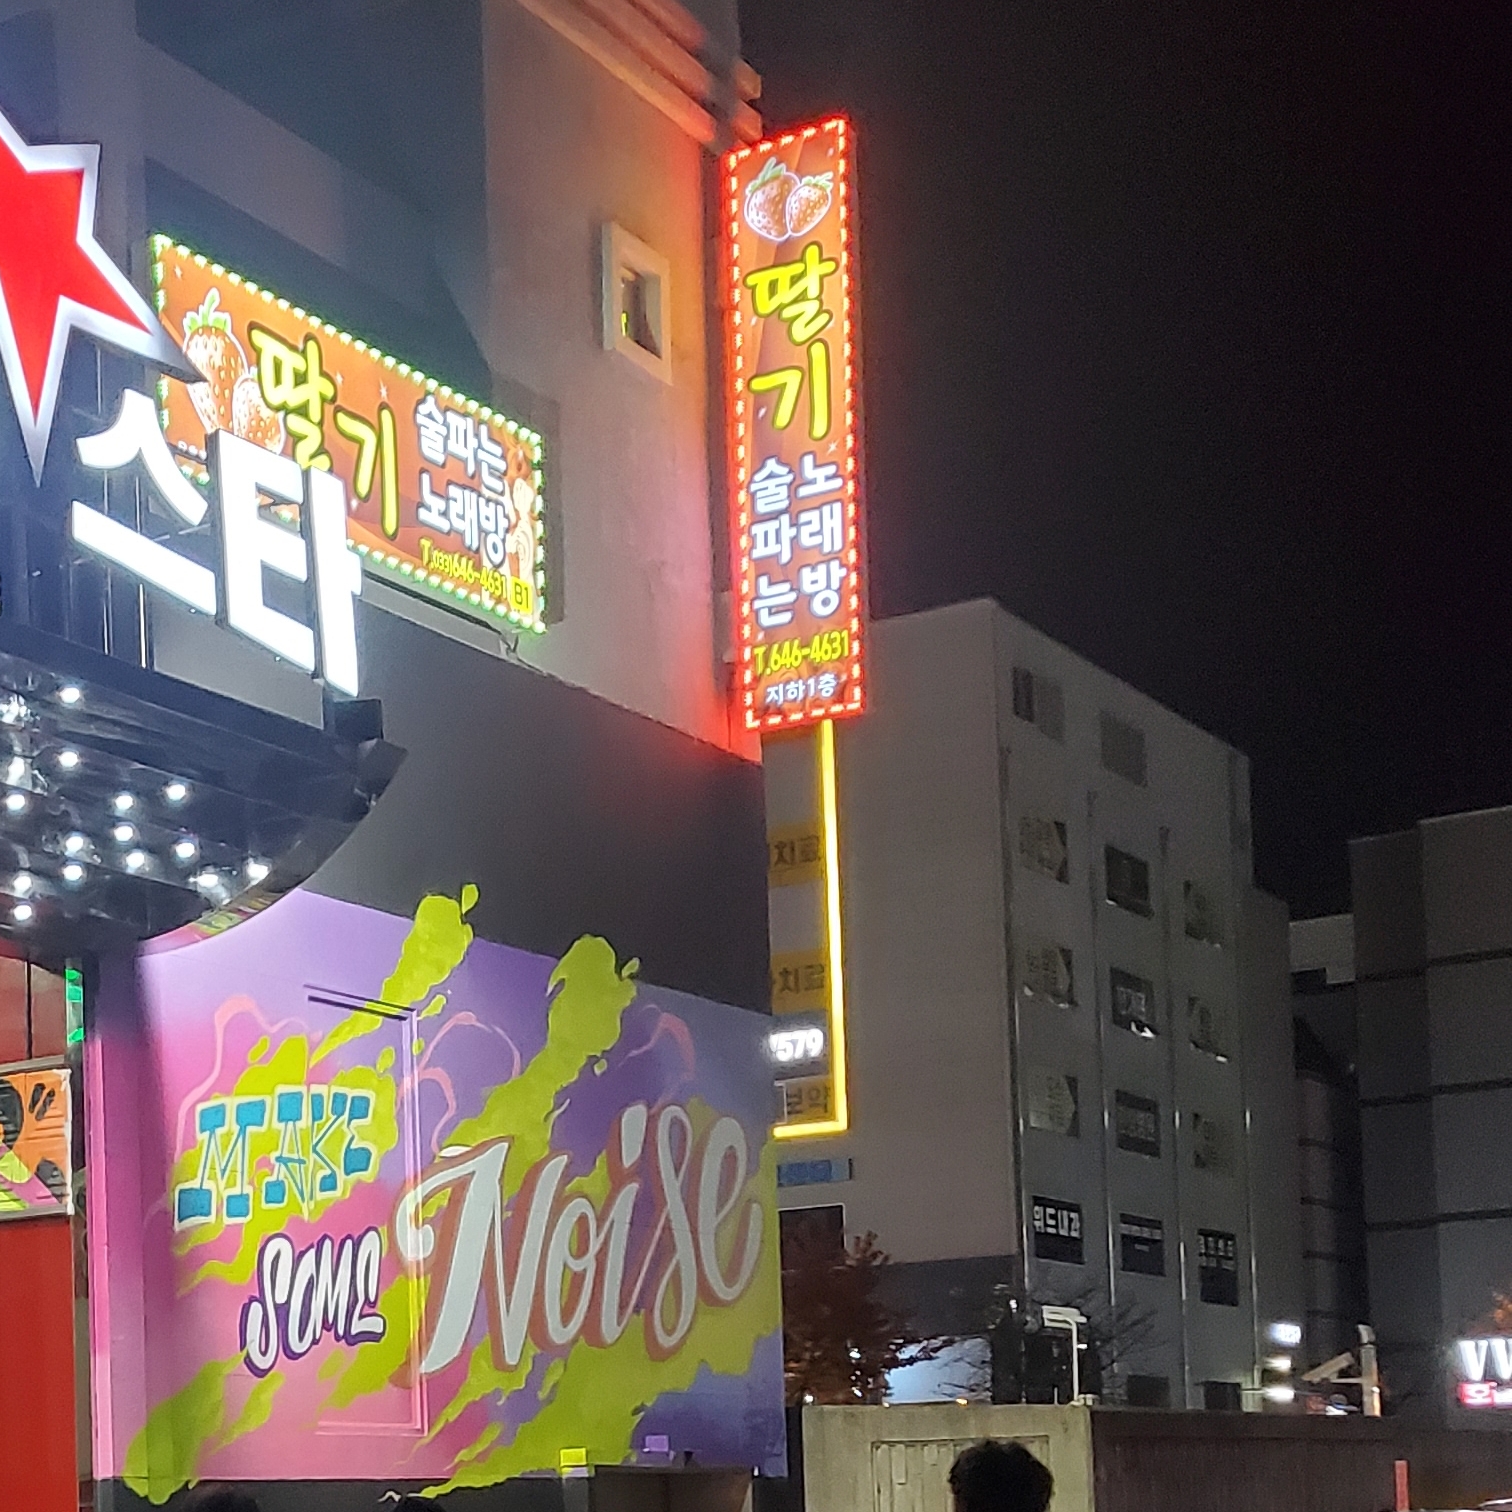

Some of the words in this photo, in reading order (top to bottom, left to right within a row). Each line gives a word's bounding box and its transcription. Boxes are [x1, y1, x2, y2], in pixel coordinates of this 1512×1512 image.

[744, 243, 837, 441] 딸기
[250, 325, 399, 538] 딸기
[415, 395, 507, 493] 술파는
[72, 387, 362, 698] 스타
[418, 471, 510, 567] 노래방
[750, 455, 797, 627] 술파는
[796, 452, 847, 618] 노래방
[513, 580, 532, 611] B1
[754, 629, 850, 675] T.646-4631
[764, 672, 838, 704] 지하1층
[174, 1084, 377, 1231] MAKE
[243, 1230, 384, 1376] SOME
